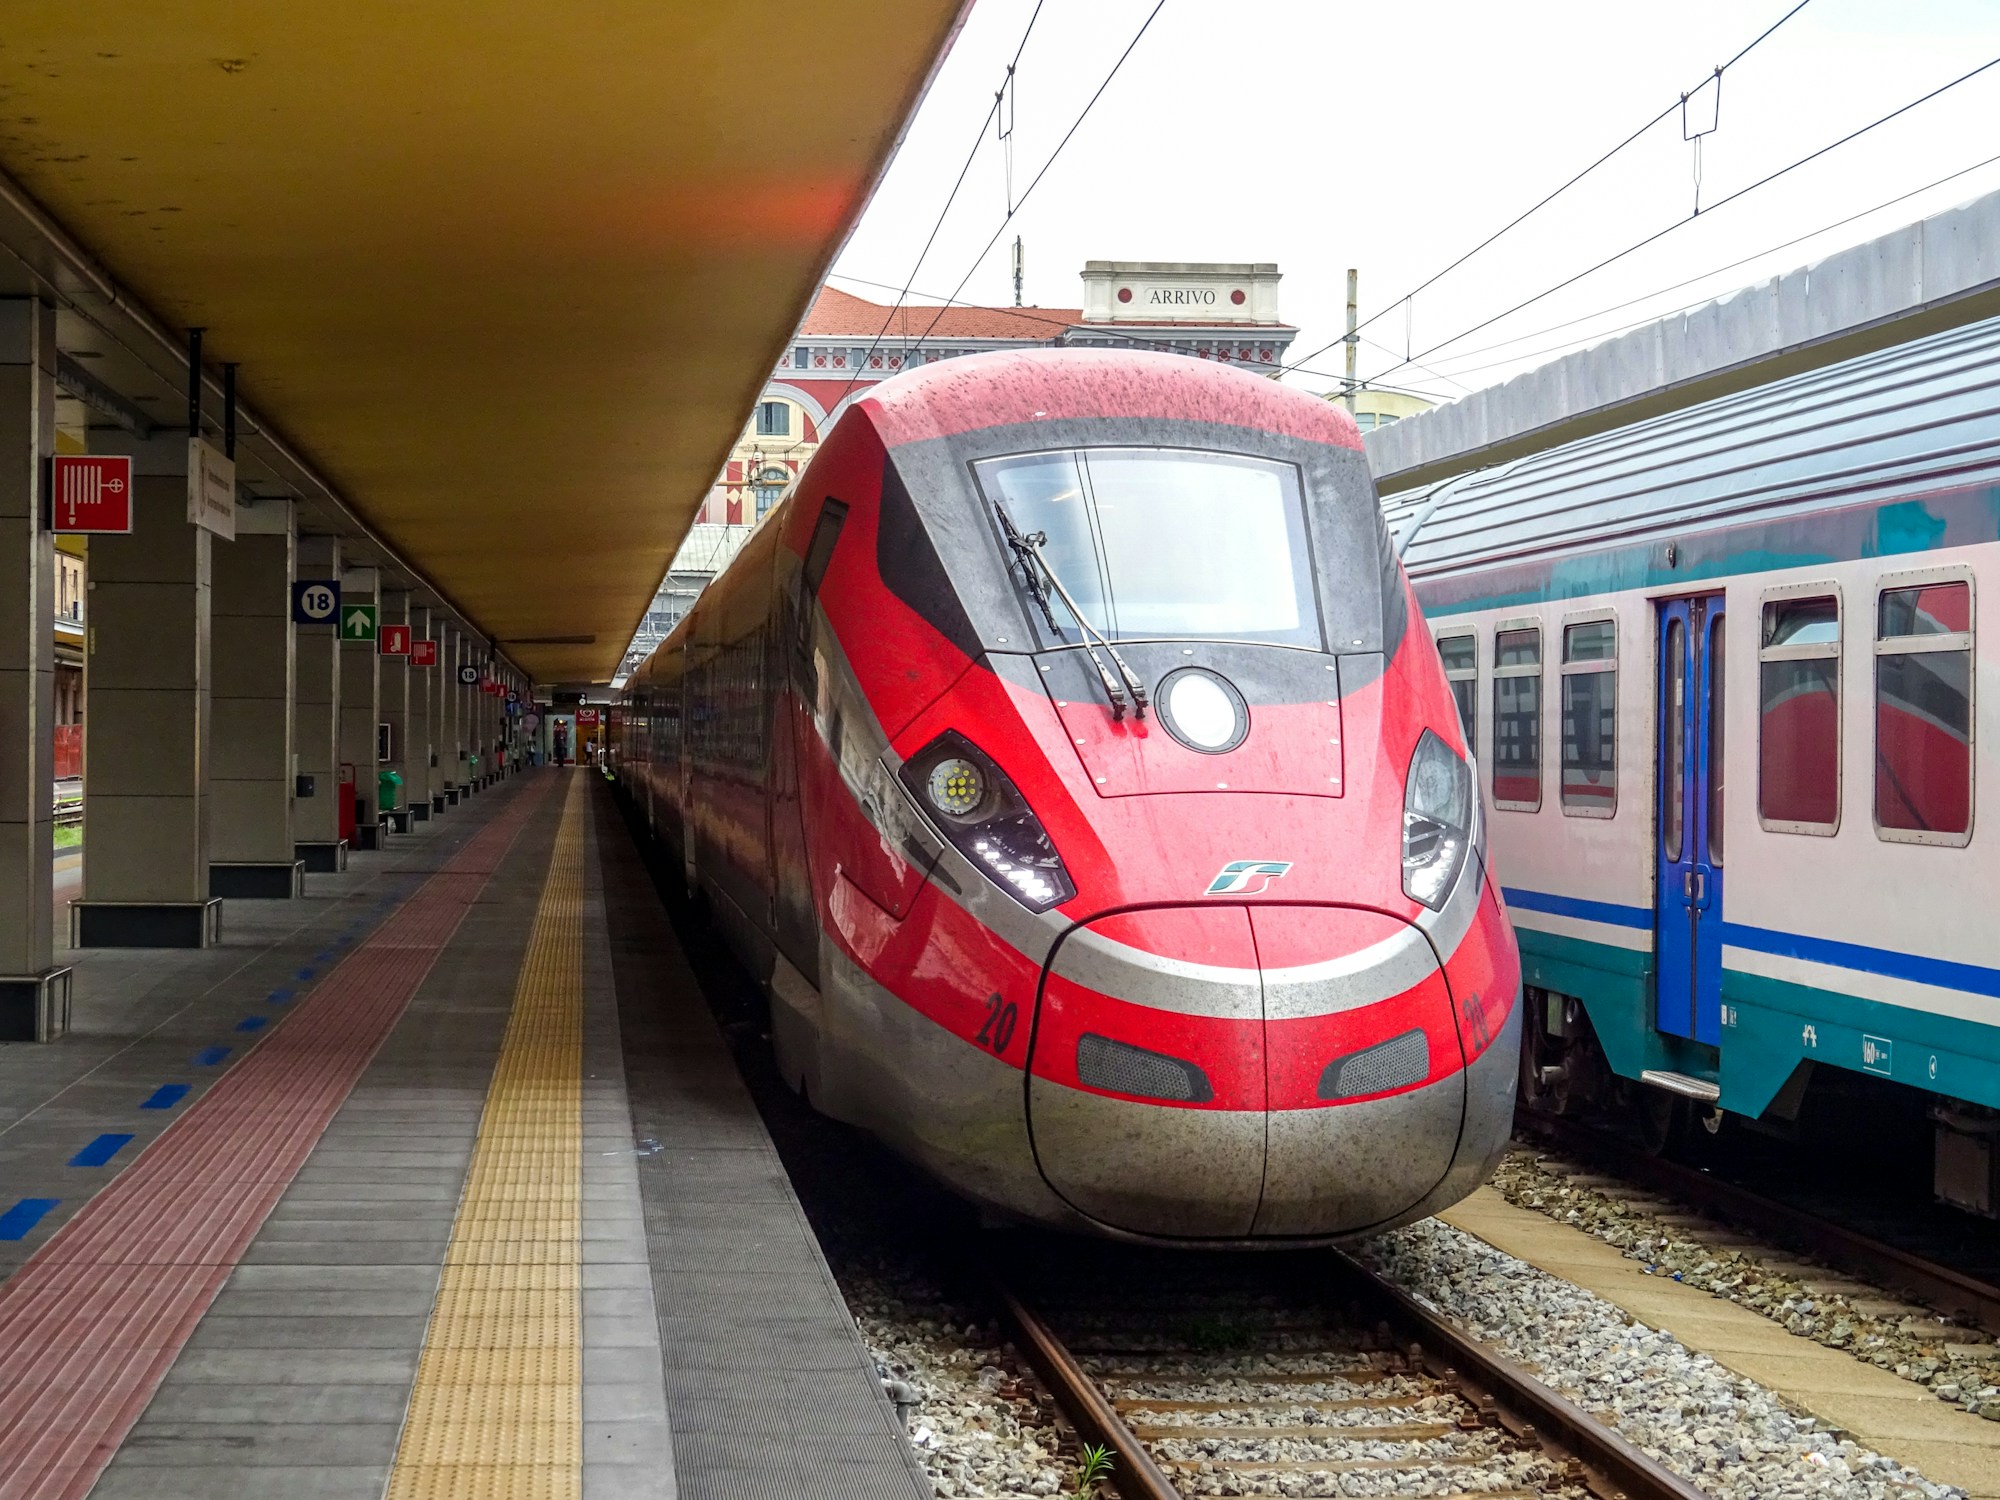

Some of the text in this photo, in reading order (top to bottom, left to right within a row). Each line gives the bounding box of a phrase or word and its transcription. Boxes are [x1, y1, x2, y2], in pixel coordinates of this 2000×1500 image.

[1150, 290, 1216, 305] ARRIVO
[307, 593, 330, 611] 18
[464, 671, 475, 679] 18
[976, 992, 1017, 1054] 20
[1463, 992, 1489, 1052] 20
[1863, 1041, 1876, 1065] 160
